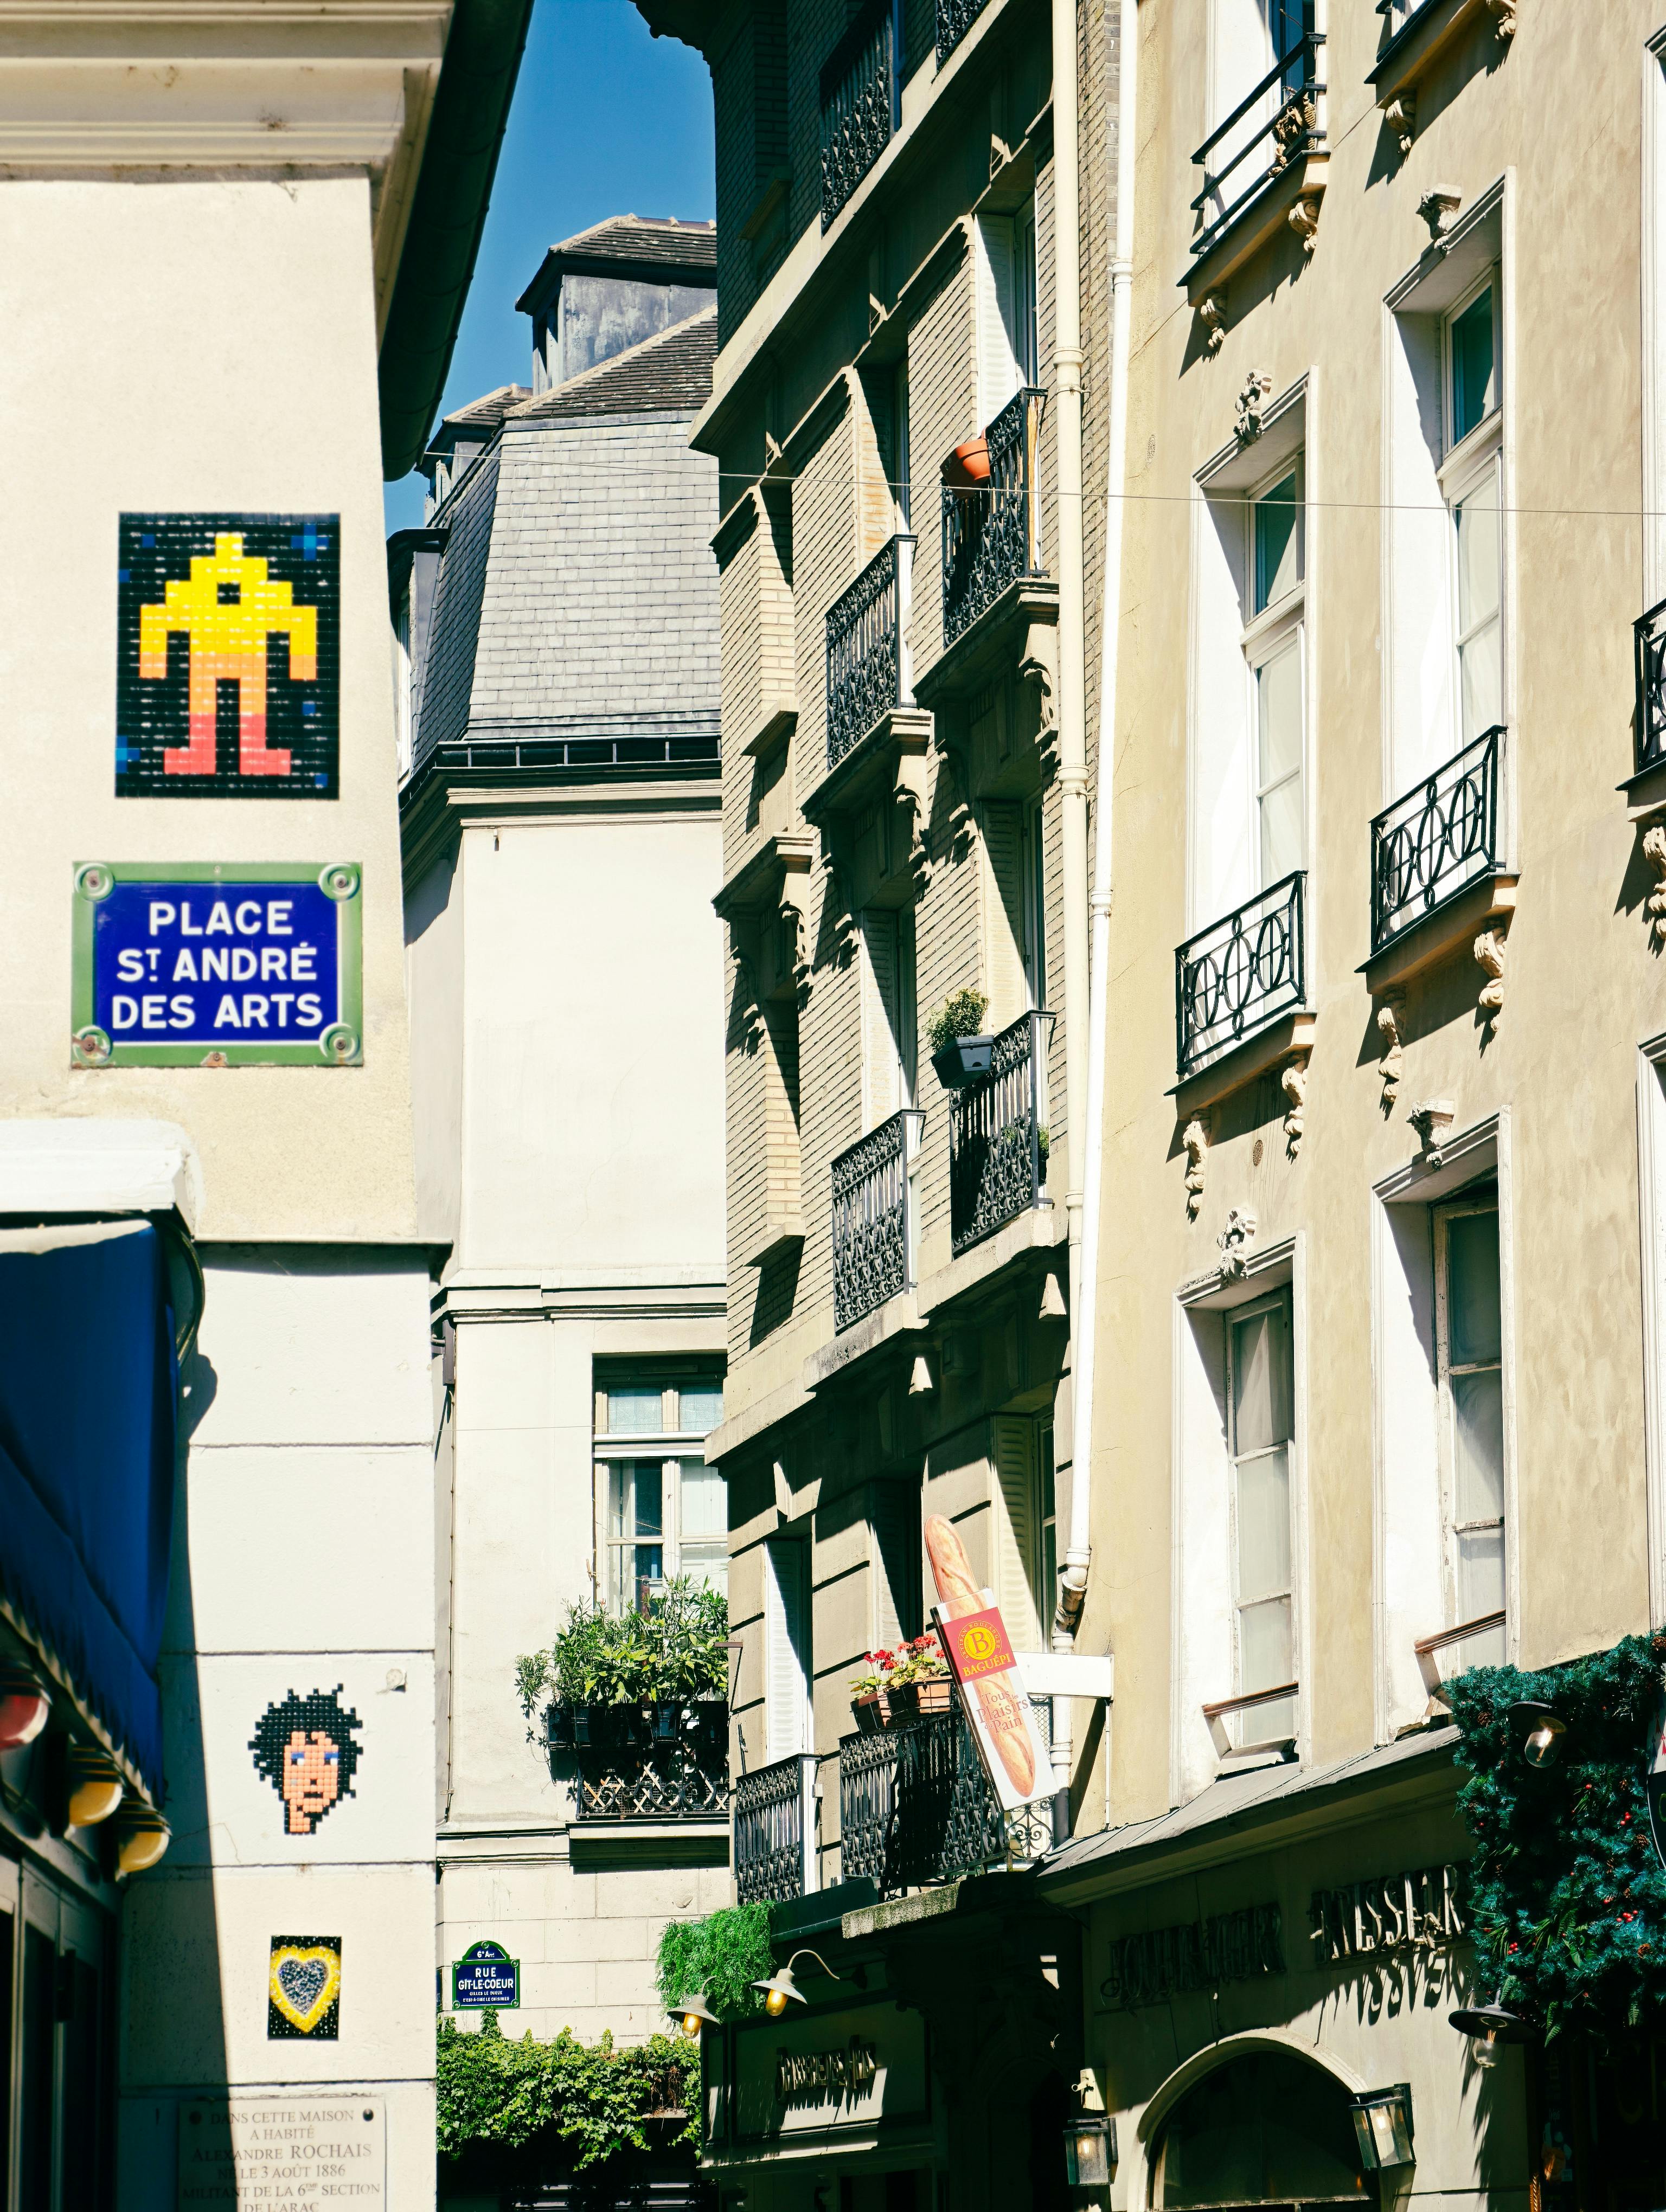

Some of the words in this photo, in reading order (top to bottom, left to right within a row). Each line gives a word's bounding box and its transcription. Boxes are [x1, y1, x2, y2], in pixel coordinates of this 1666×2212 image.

[149, 901, 293, 936] PLACE
[172, 941, 318, 982] ANDRÉ
[111, 995, 196, 1030] DES
[213, 993, 324, 1028] ARTS
[958, 1629, 970, 1660] ARTISAN
[969, 1621, 1001, 1649] BOULANGER
[969, 1631, 990, 1655] B
[982, 1690, 1010, 1705] Tous
[976, 1699, 1029, 1724] Plaisirs
[992, 1717, 1023, 1734] Pain
[475, 1967, 496, 1977] RUE
[210, 2112, 248, 2125] DANS
[252, 2111, 297, 2124] CETTE
[299, 2110, 355, 2122] MAISON
[250, 2130, 260, 2140] A
[264, 2125, 315, 2139] HABITÉ
[191, 2147, 283, 2162] ALEXANDRE
[290, 2144, 372, 2159] ROCHAIS
[240, 2168, 257, 2179] LE
[261, 2166, 268, 2178] 3
[272, 2164, 311, 2177] AOÛT
[316, 2164, 346, 2177] 1886
[182, 2187, 249, 2200] MILITANT
[254, 2187, 272, 2197] DE
[275, 2186, 293, 2197] LA
[322, 2183, 381, 2196] SECTION
[244, 2204, 262, 2212] DE
[267, 2202, 319, 2212] L'ARAC
